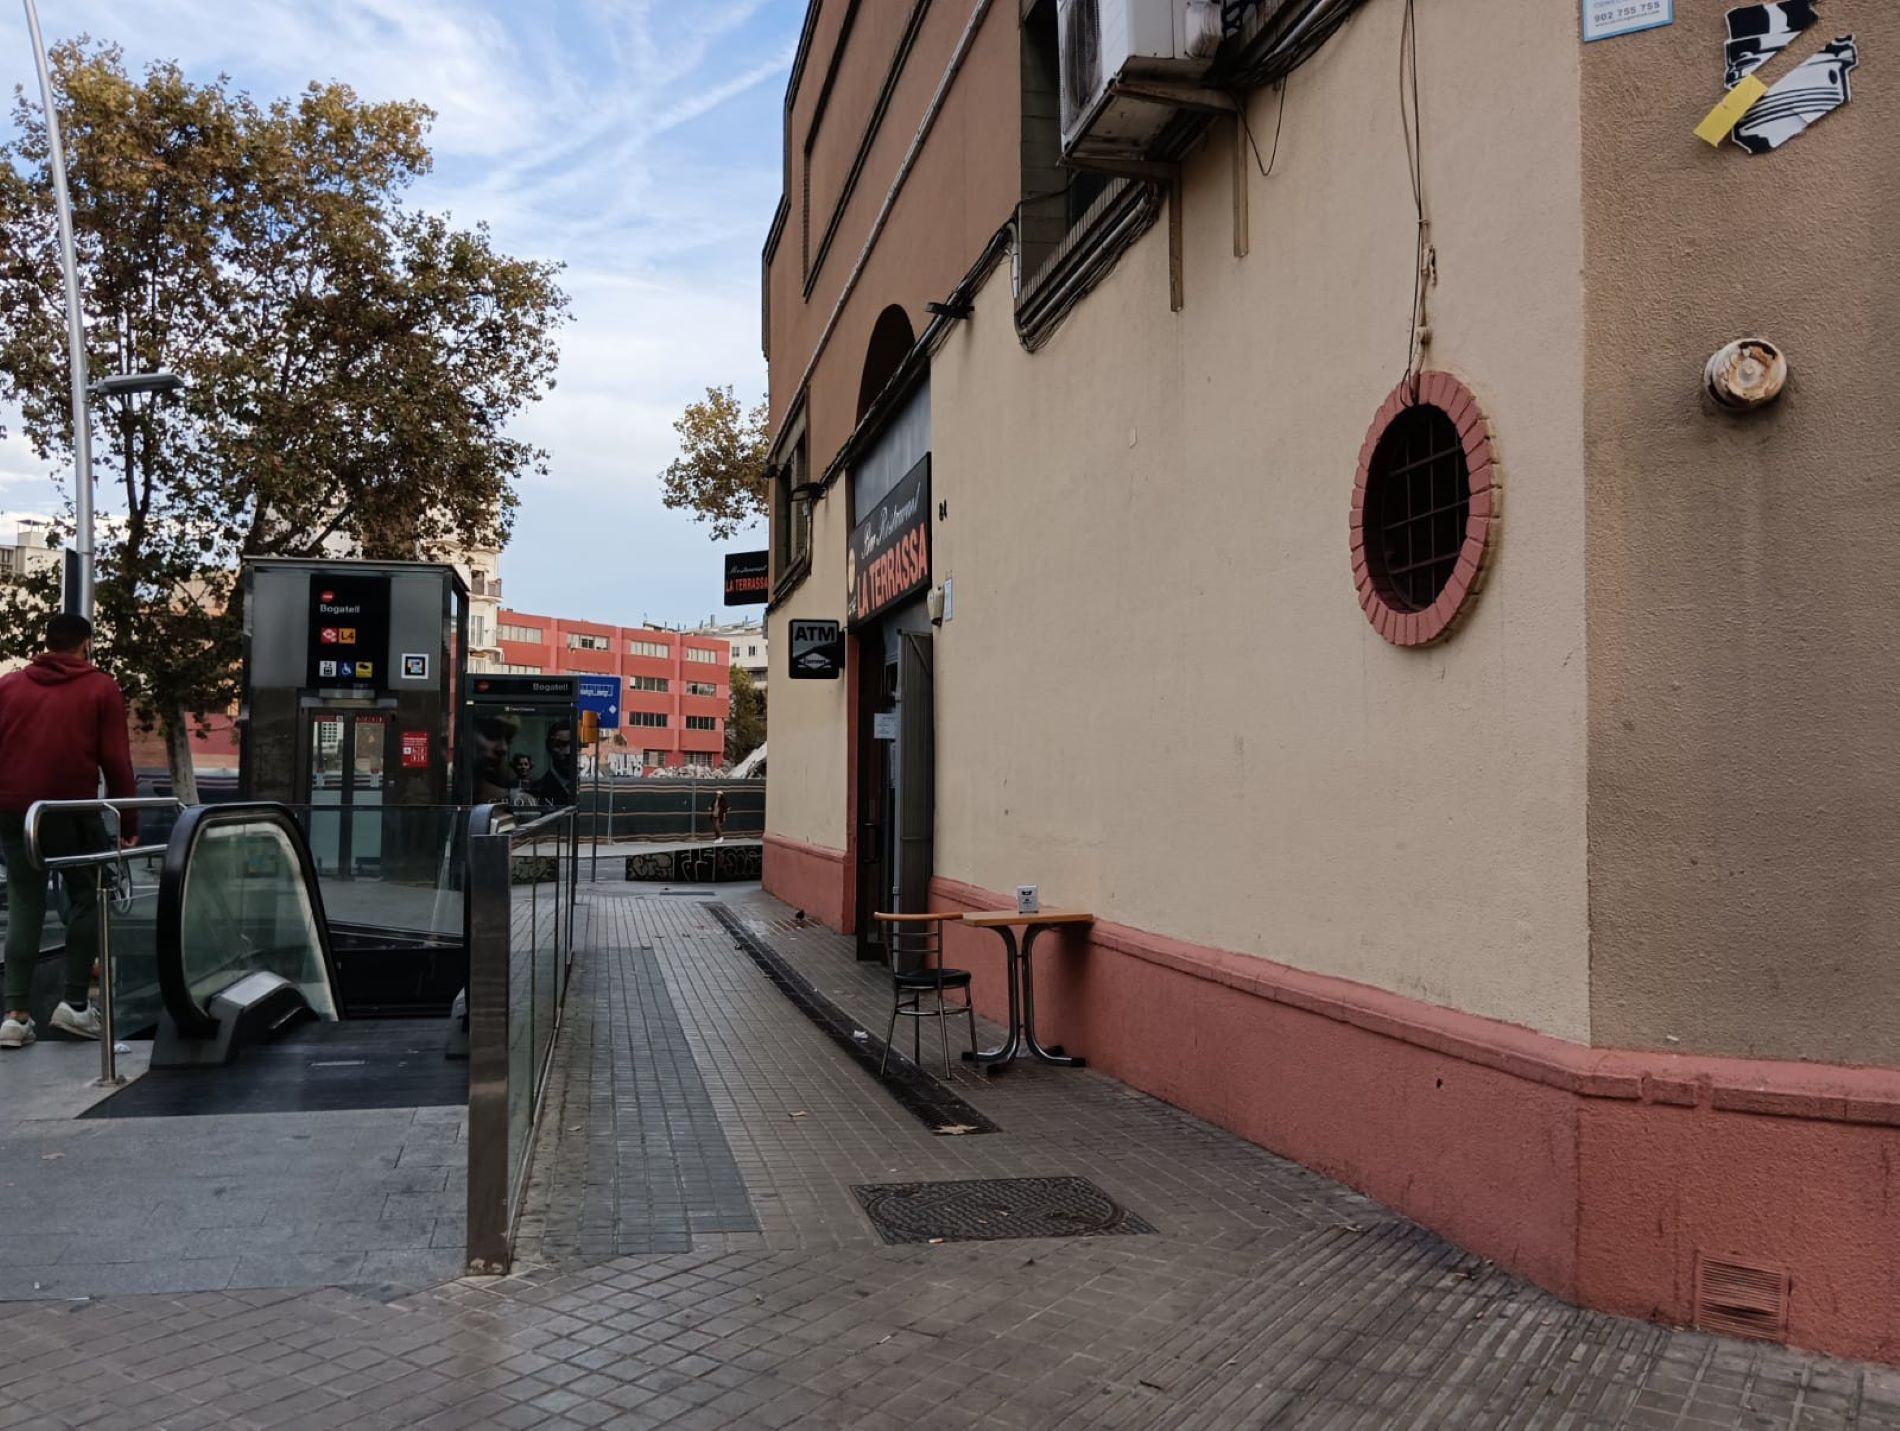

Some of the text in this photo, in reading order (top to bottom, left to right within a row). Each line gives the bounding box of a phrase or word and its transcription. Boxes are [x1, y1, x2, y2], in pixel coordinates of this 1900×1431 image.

[1594, 11, 1613, 22] 902
[1617, 6, 1637, 17] 755
[1640, 1, 1660, 12] 755
[856, 522, 928, 620] LA TERRASSA
[726, 576, 769, 592] LA TERRASSA
[320, 603, 360, 614] Bogatell
[341, 631, 355, 641] L4
[795, 626, 836, 641] ATM
[532, 682, 569, 692] Bogatell
